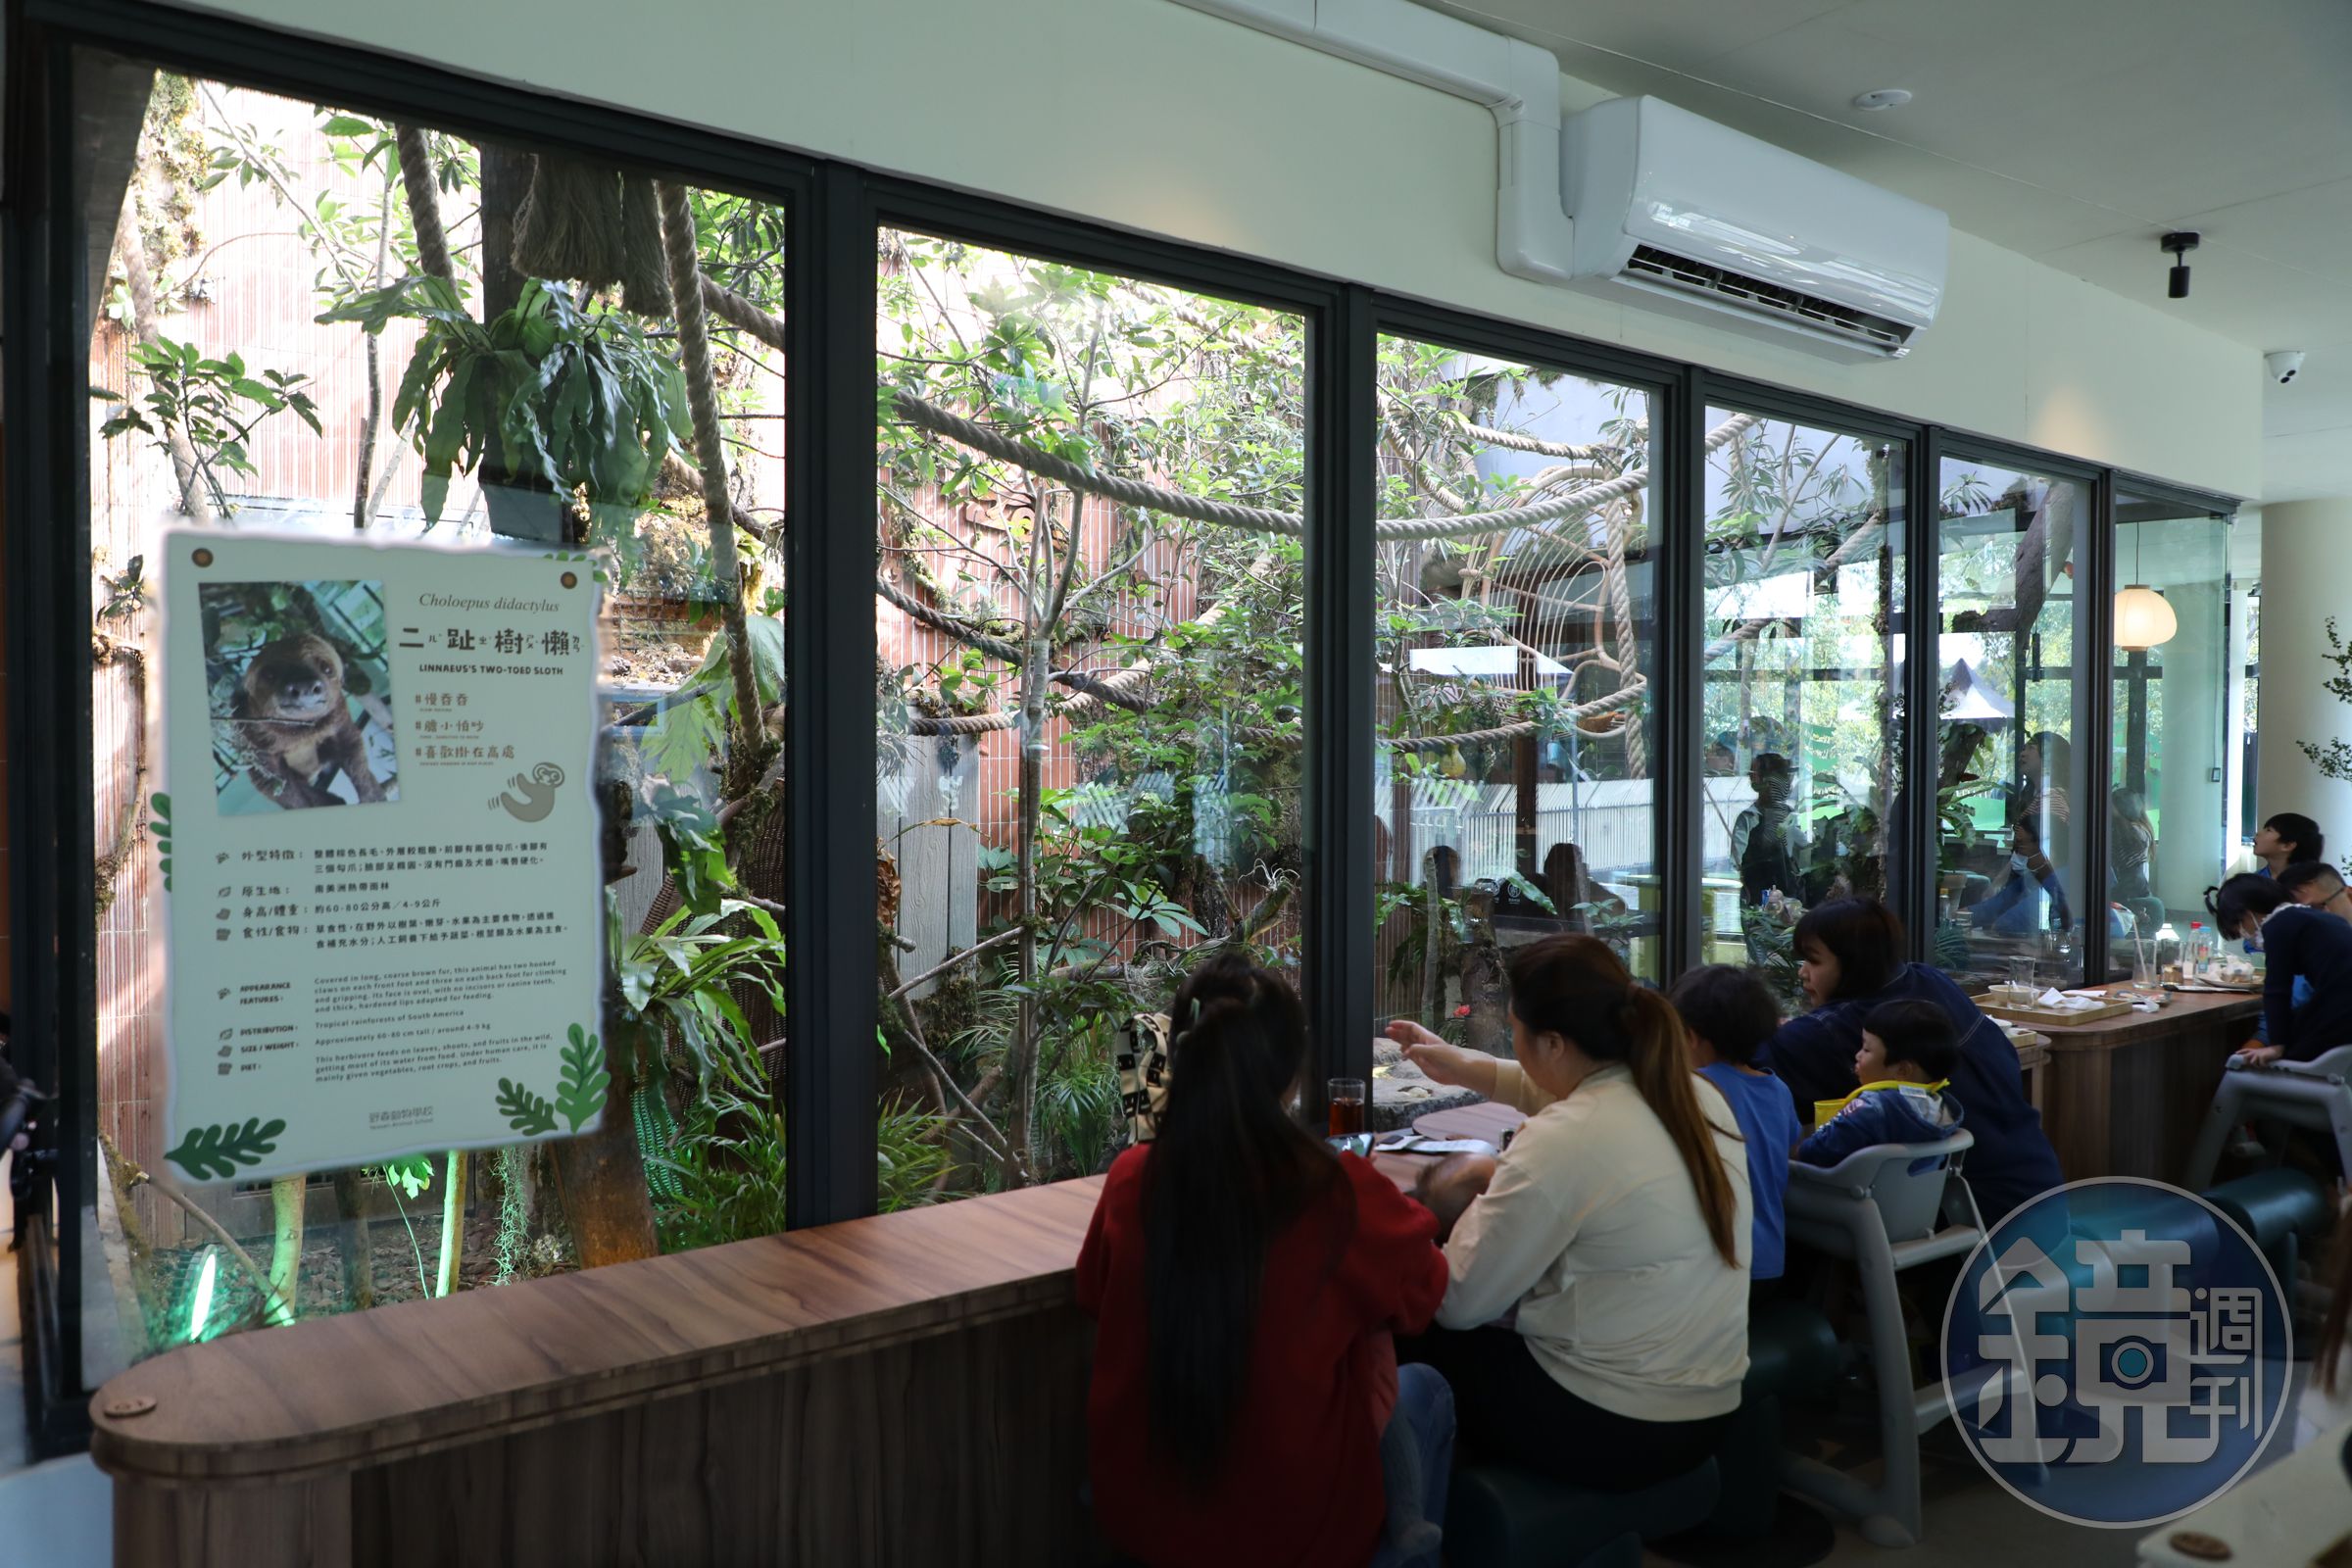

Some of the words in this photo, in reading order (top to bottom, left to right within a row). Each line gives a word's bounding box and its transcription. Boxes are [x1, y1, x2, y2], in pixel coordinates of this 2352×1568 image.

[419, 593, 490, 612] Choloepus
[494, 597, 560, 614] didactylus
[419, 664, 476, 673] LINNAEUS'S
[480, 665, 531, 674] TWO-TOED
[534, 666, 564, 675] SLOTH
